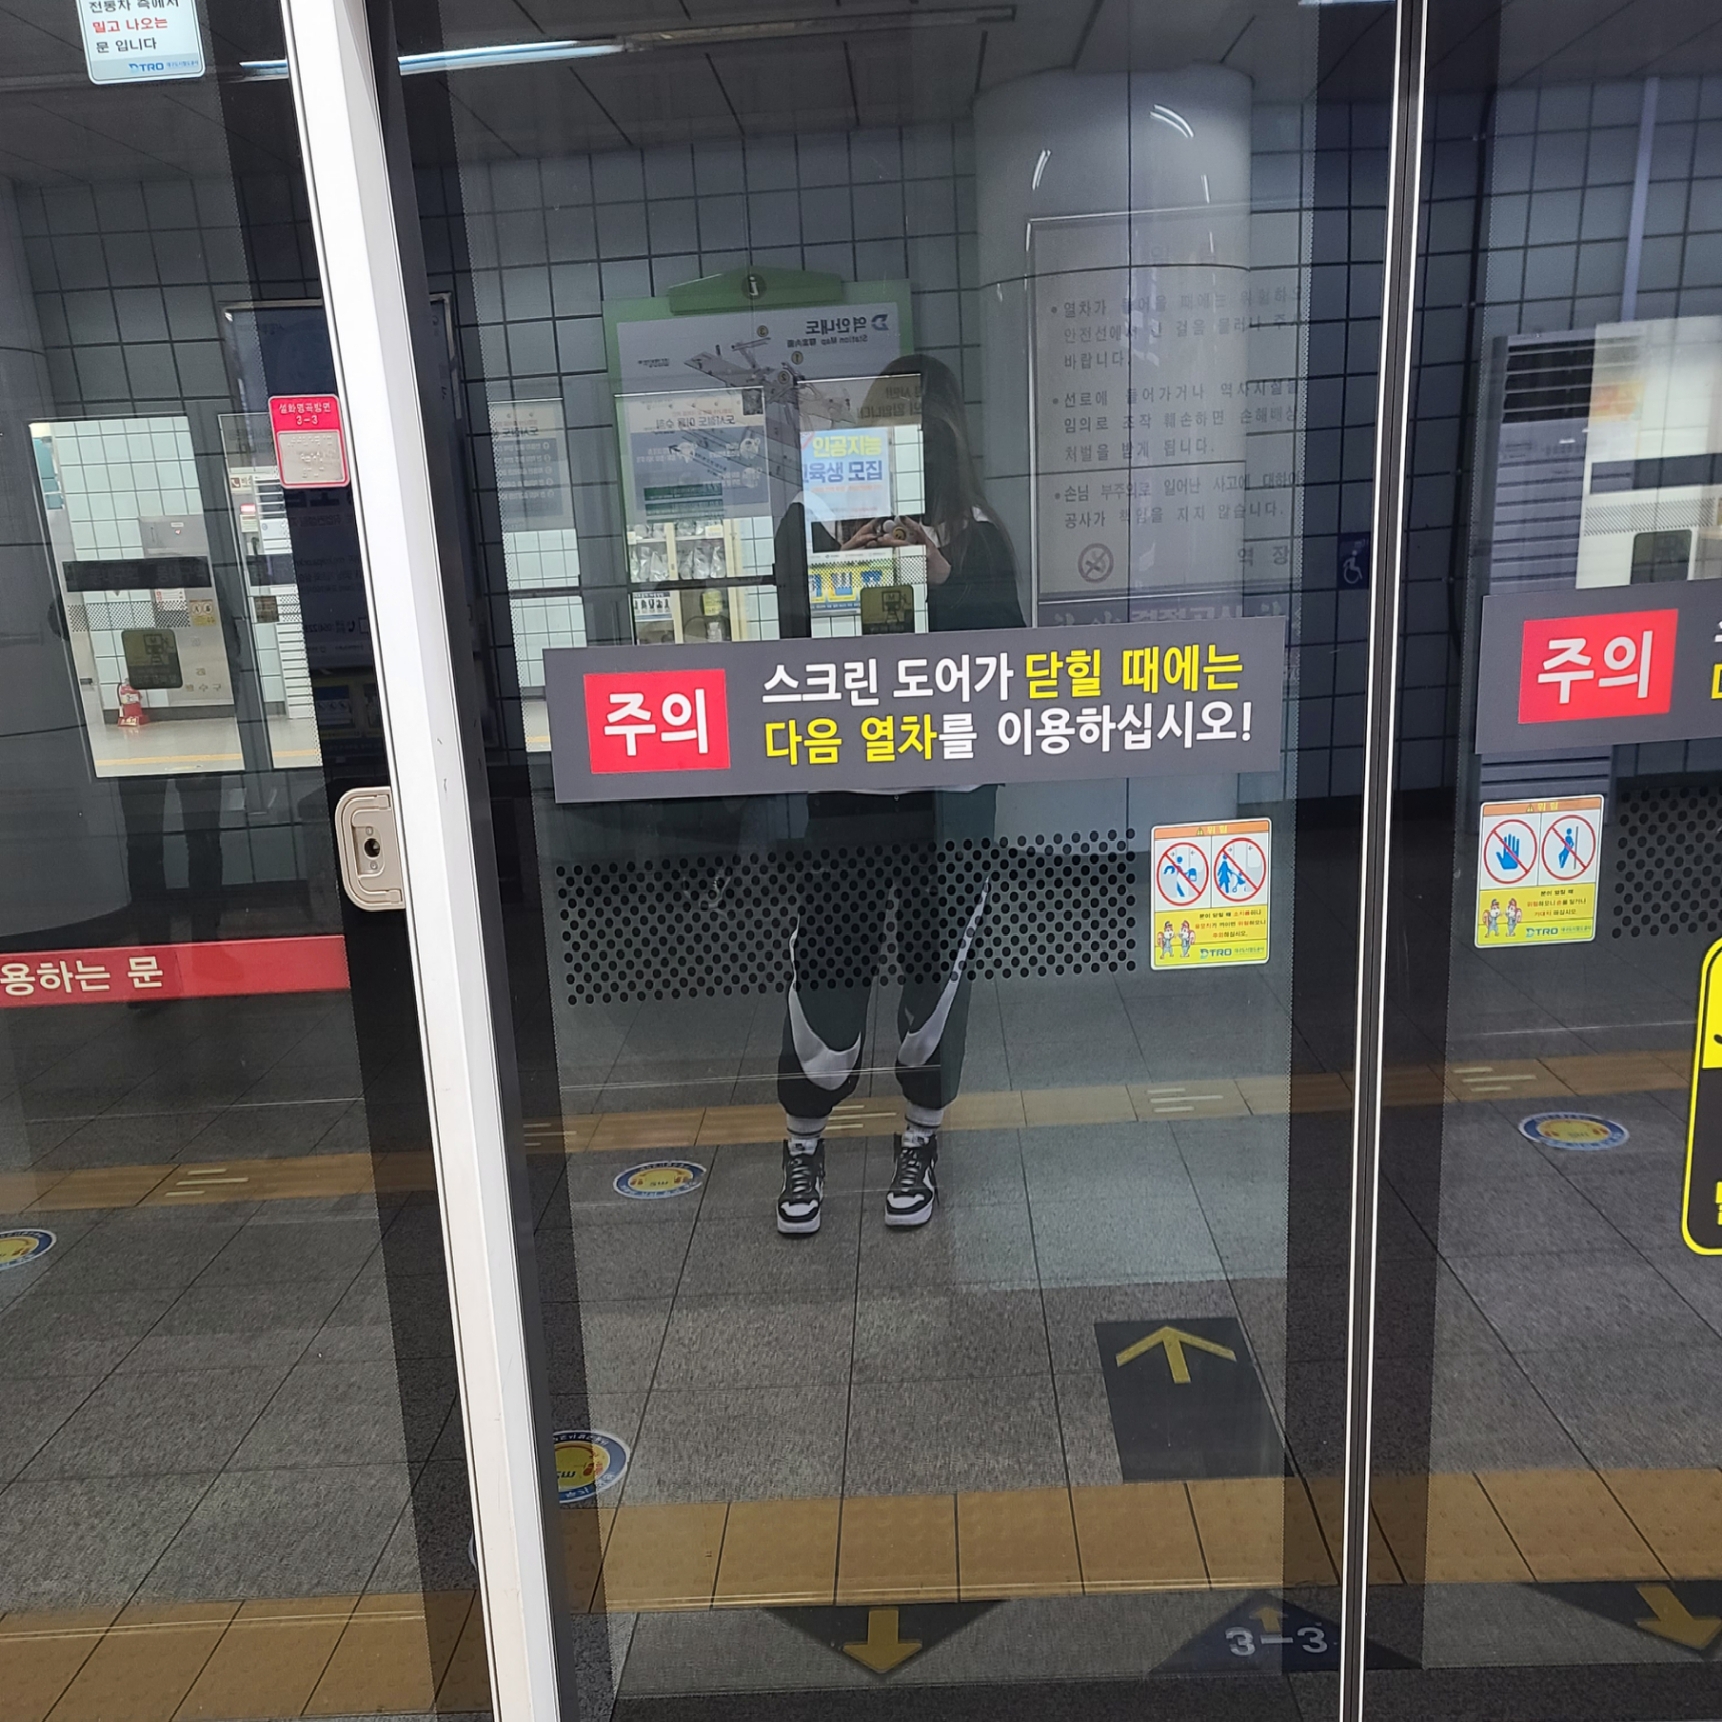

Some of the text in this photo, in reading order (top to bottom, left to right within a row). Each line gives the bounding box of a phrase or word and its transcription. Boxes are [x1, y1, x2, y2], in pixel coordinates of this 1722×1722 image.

[89, 0, 131, 14] 전동차
[92, 17, 168, 34] 밀고 나오는
[96, 37, 157, 54] 문 입니다
[128, 62, 165, 74] DTRO
[1063, 300, 1107, 318] 열차가
[1176, 318, 1206, 338] 걸음
[1063, 389, 1109, 408] 선로에
[296, 415, 319, 426] 3-3
[1063, 416, 1109, 434] 임의로
[1122, 412, 1152, 431] 조작
[1163, 409, 1225, 428] 훼손하면
[812, 435, 882, 458] 인공지능
[1063, 437, 1215, 463] 처벌을 받게 됩니다.
[848, 460, 883, 482] 모집
[1063, 483, 1090, 503] 손님
[1163, 476, 1202, 497] 일어난
[1063, 510, 1106, 530] 공사가
[1176, 504, 1206, 523] 지지
[1217, 501, 1285, 521] 않습니다.
[761, 642, 1245, 706] 스크린 도어가 닫힐 때에는
[1537, 630, 1654, 704] 주의
[603, 688, 711, 757] 주의
[764, 698, 1253, 766] 다음 열차를 이용하십시오!
[0, 955, 165, 997] 용하는 문
[1224, 1626, 1329, 1658] 3-3
